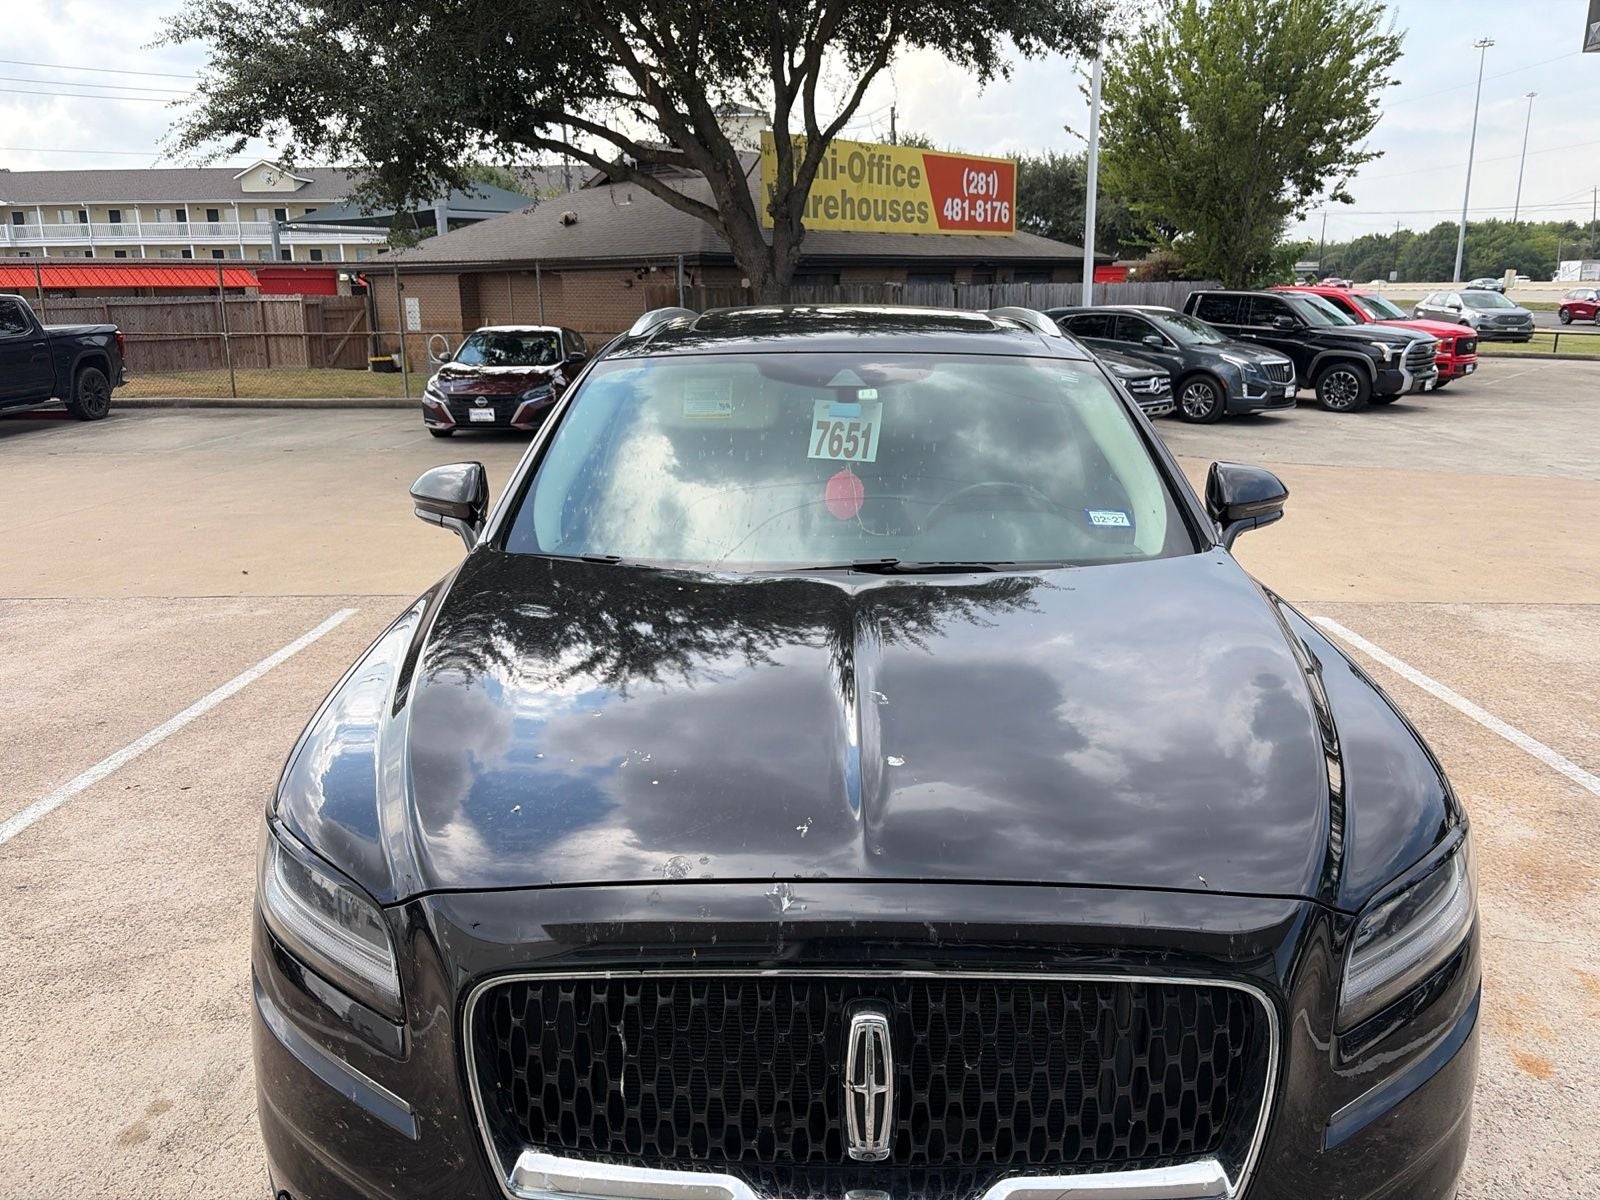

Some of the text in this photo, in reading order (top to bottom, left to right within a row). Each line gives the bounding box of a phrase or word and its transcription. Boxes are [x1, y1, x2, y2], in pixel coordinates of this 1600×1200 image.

[962, 167, 998, 199] (281)
[943, 198, 1010, 224] 481-8176
[814, 420, 873, 459] 7651
